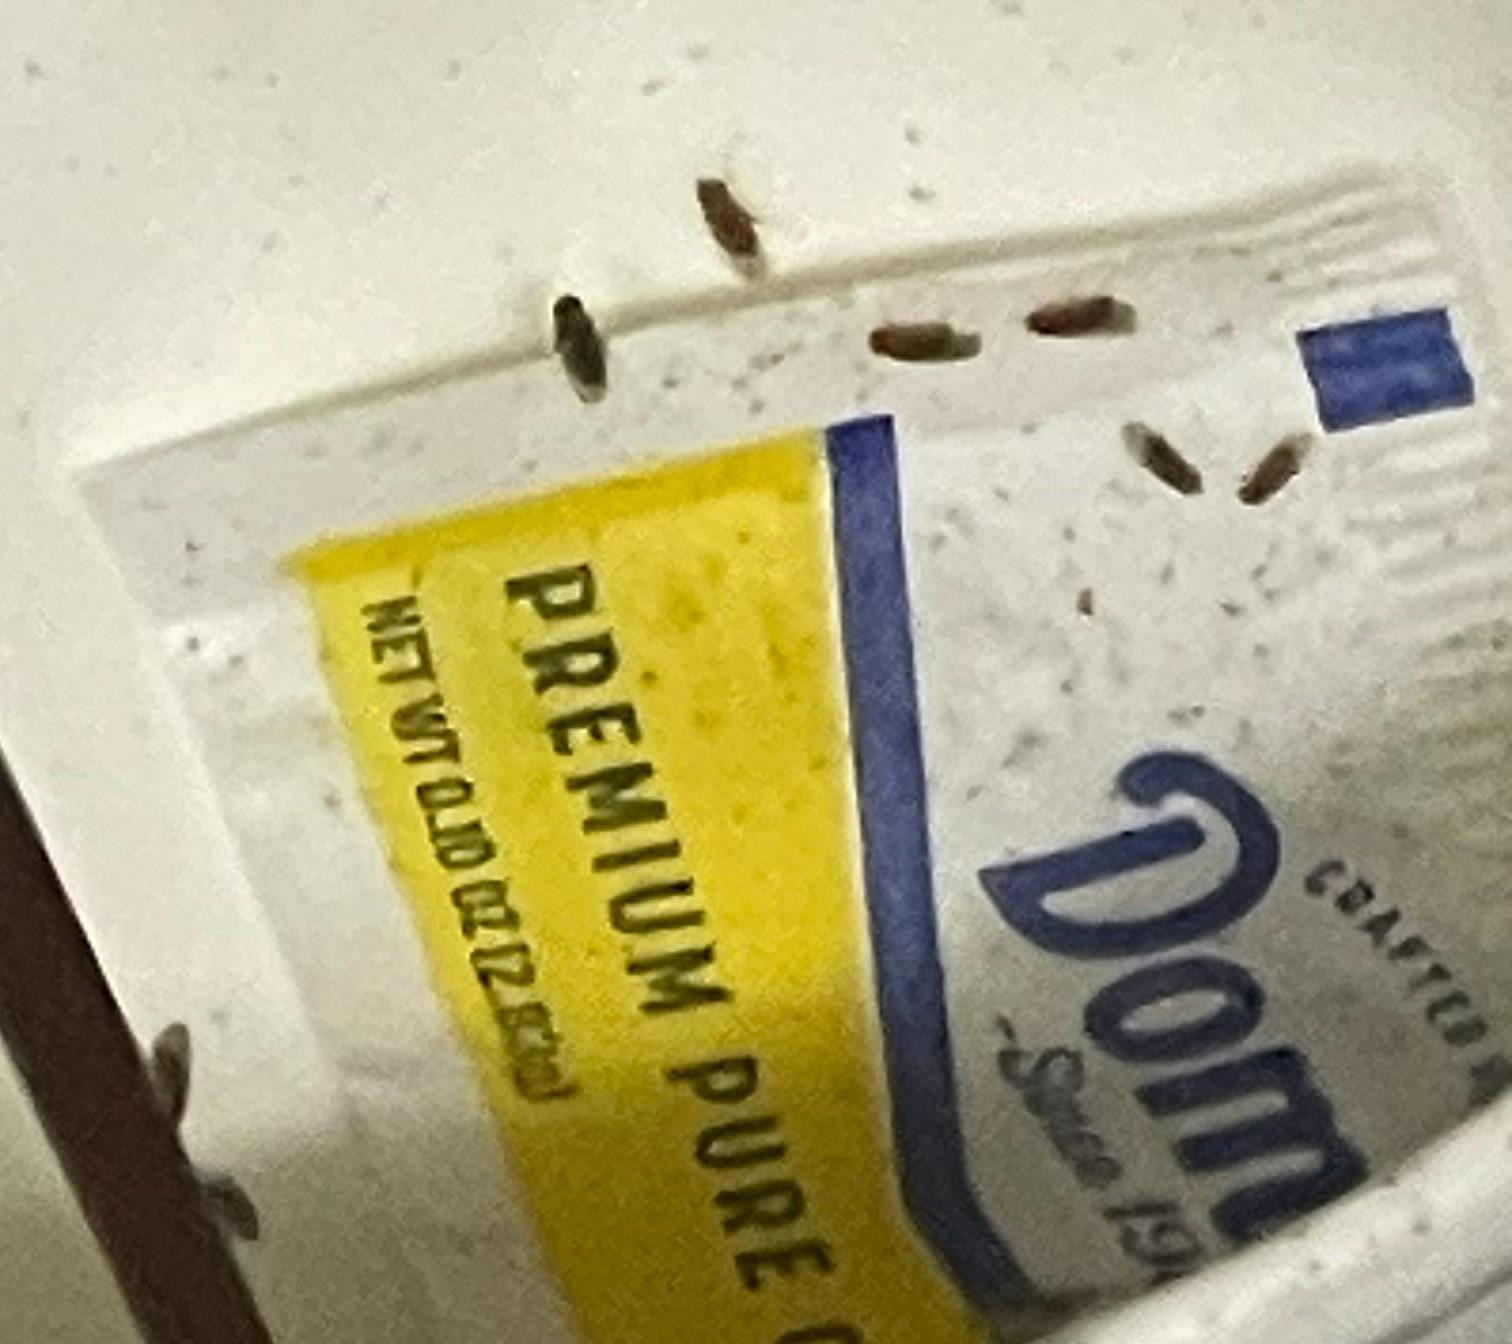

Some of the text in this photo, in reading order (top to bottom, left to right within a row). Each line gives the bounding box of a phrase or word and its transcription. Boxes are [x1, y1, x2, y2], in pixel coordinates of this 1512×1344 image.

[361, 596, 436, 683] NET
[391, 692, 461, 763] WT
[504, 563, 734, 1017] PREMIUM
[665, 1055, 833, 1291] PURE
